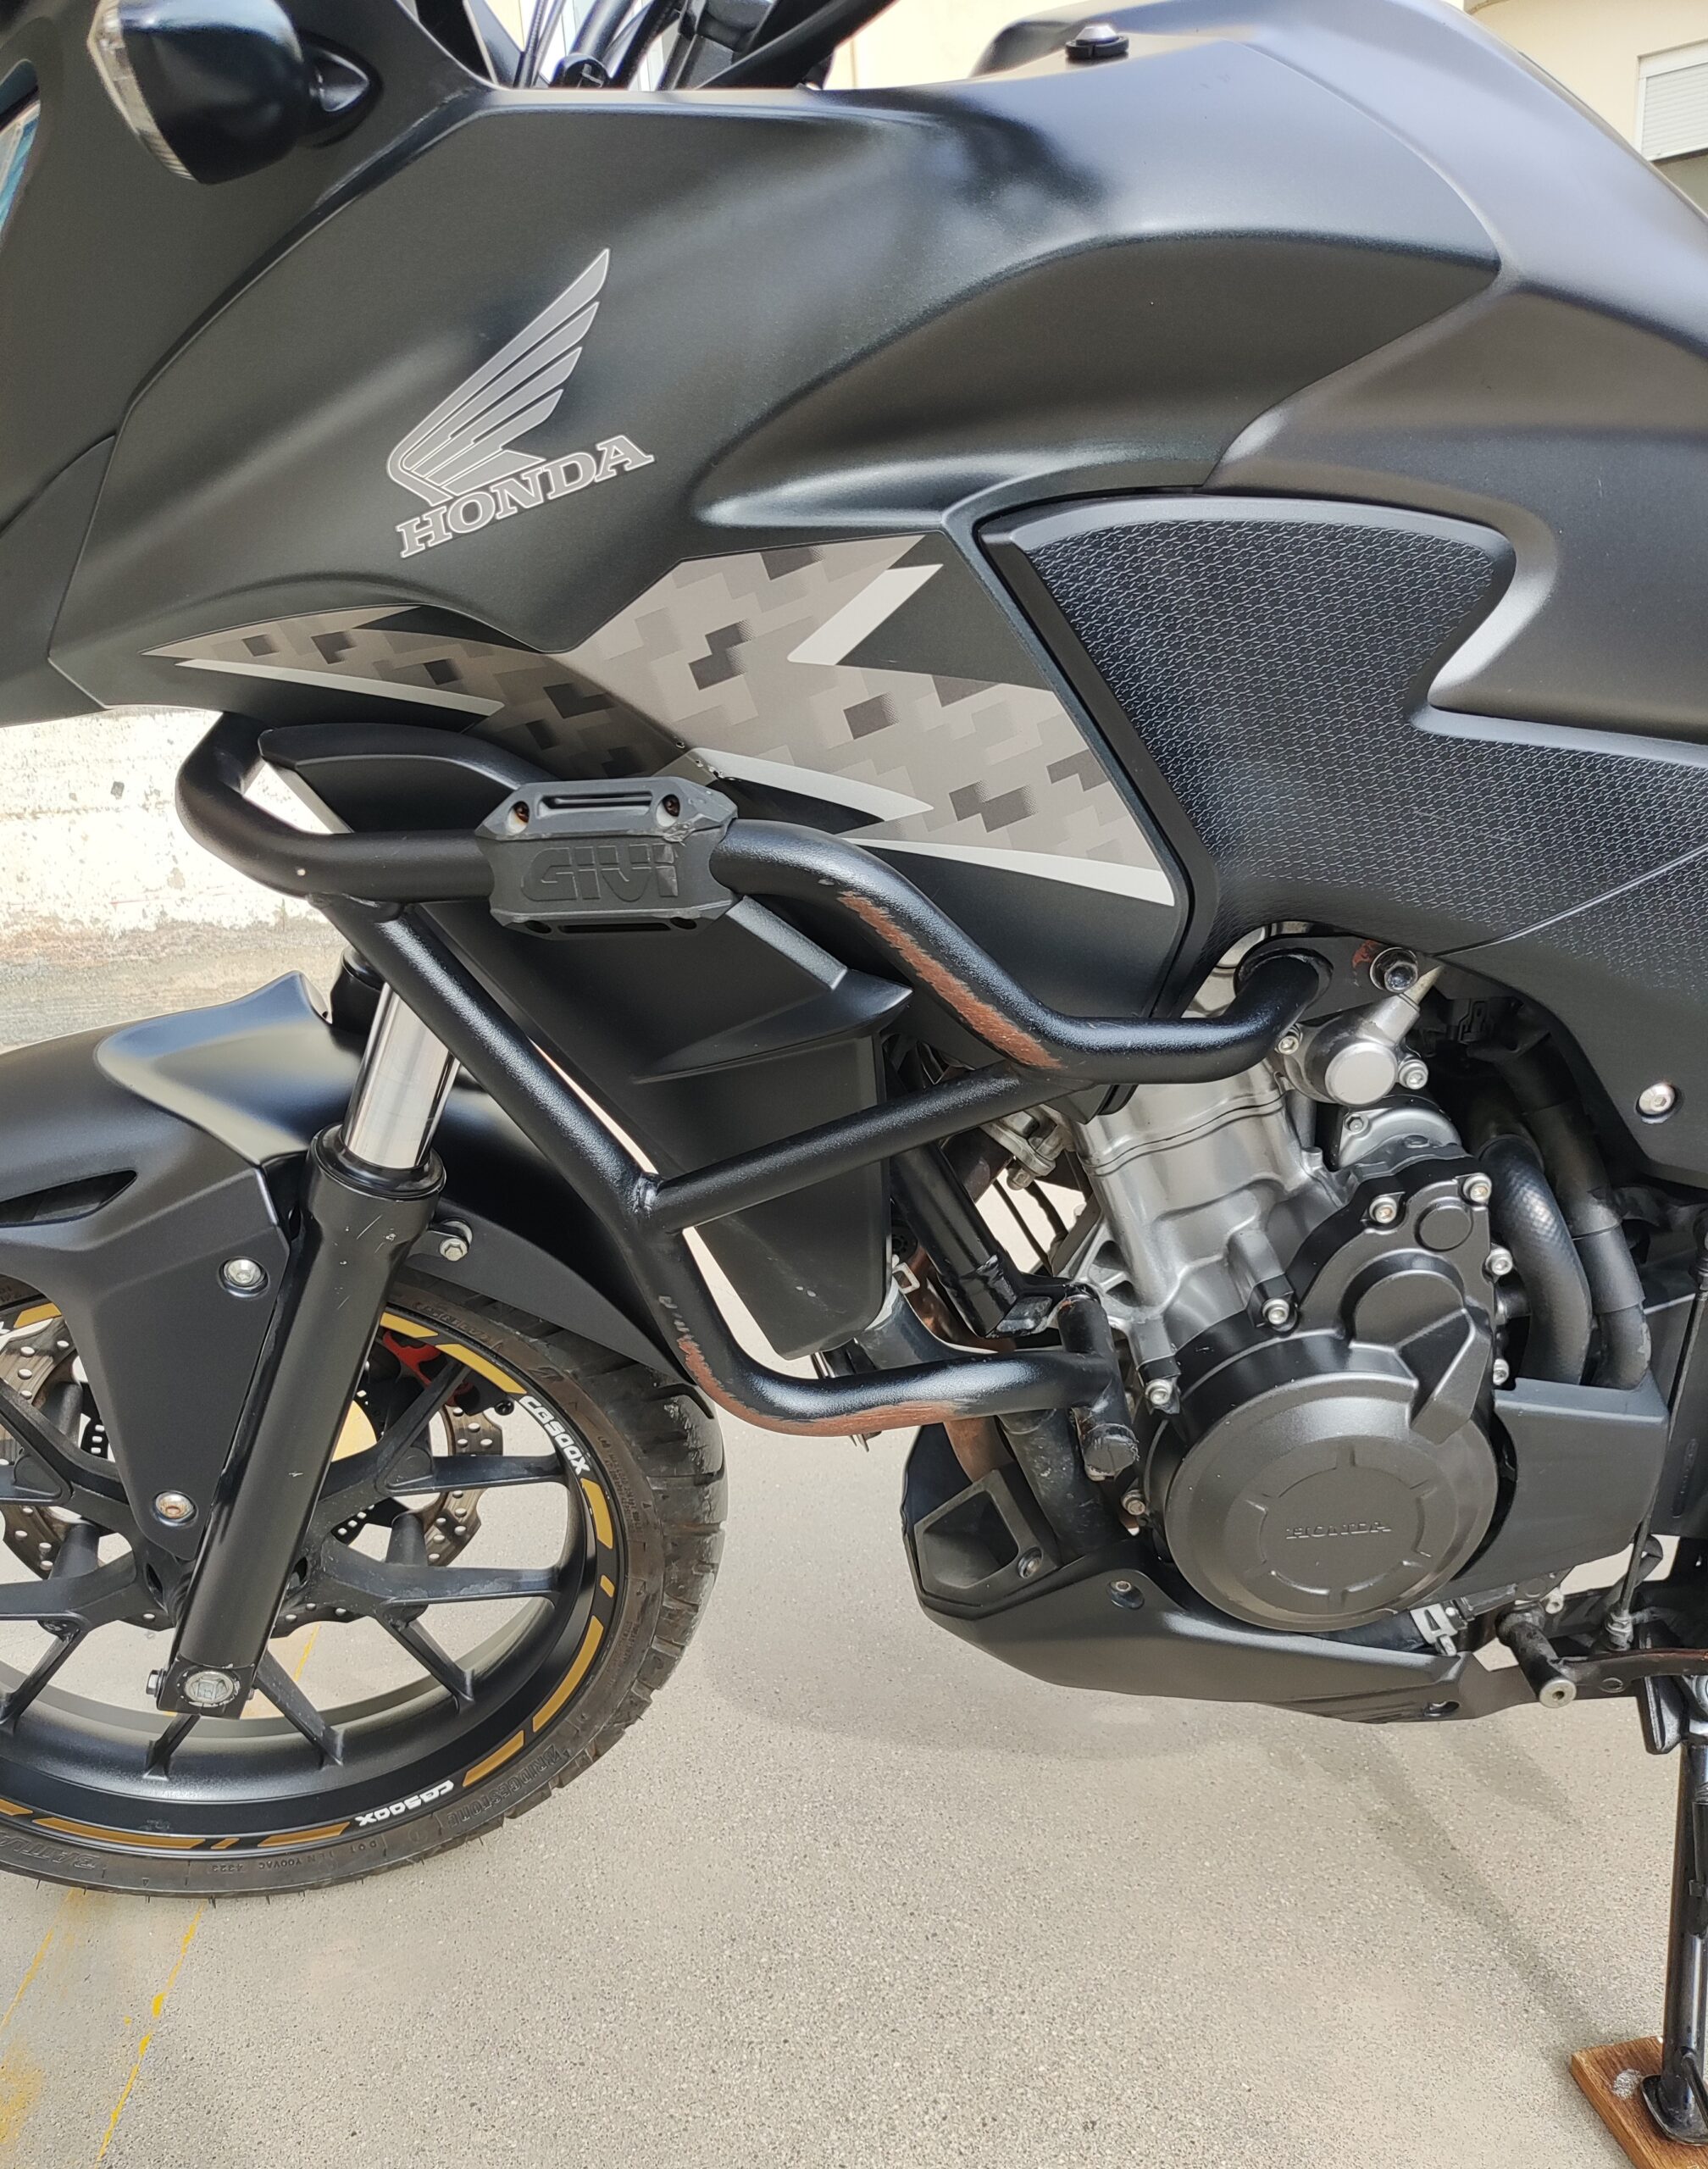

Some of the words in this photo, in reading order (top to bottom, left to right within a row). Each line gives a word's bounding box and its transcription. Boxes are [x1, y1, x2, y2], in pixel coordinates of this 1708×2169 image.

[395, 434, 655, 559] HONDA
[520, 843, 679, 902] GIVI
[518, 1395, 591, 1475] CB500X
[1285, 1522, 1392, 1539] HONDA
[354, 1779, 455, 1827] CB500X
[446, 1744, 571, 1828] BRIDGESTONE
